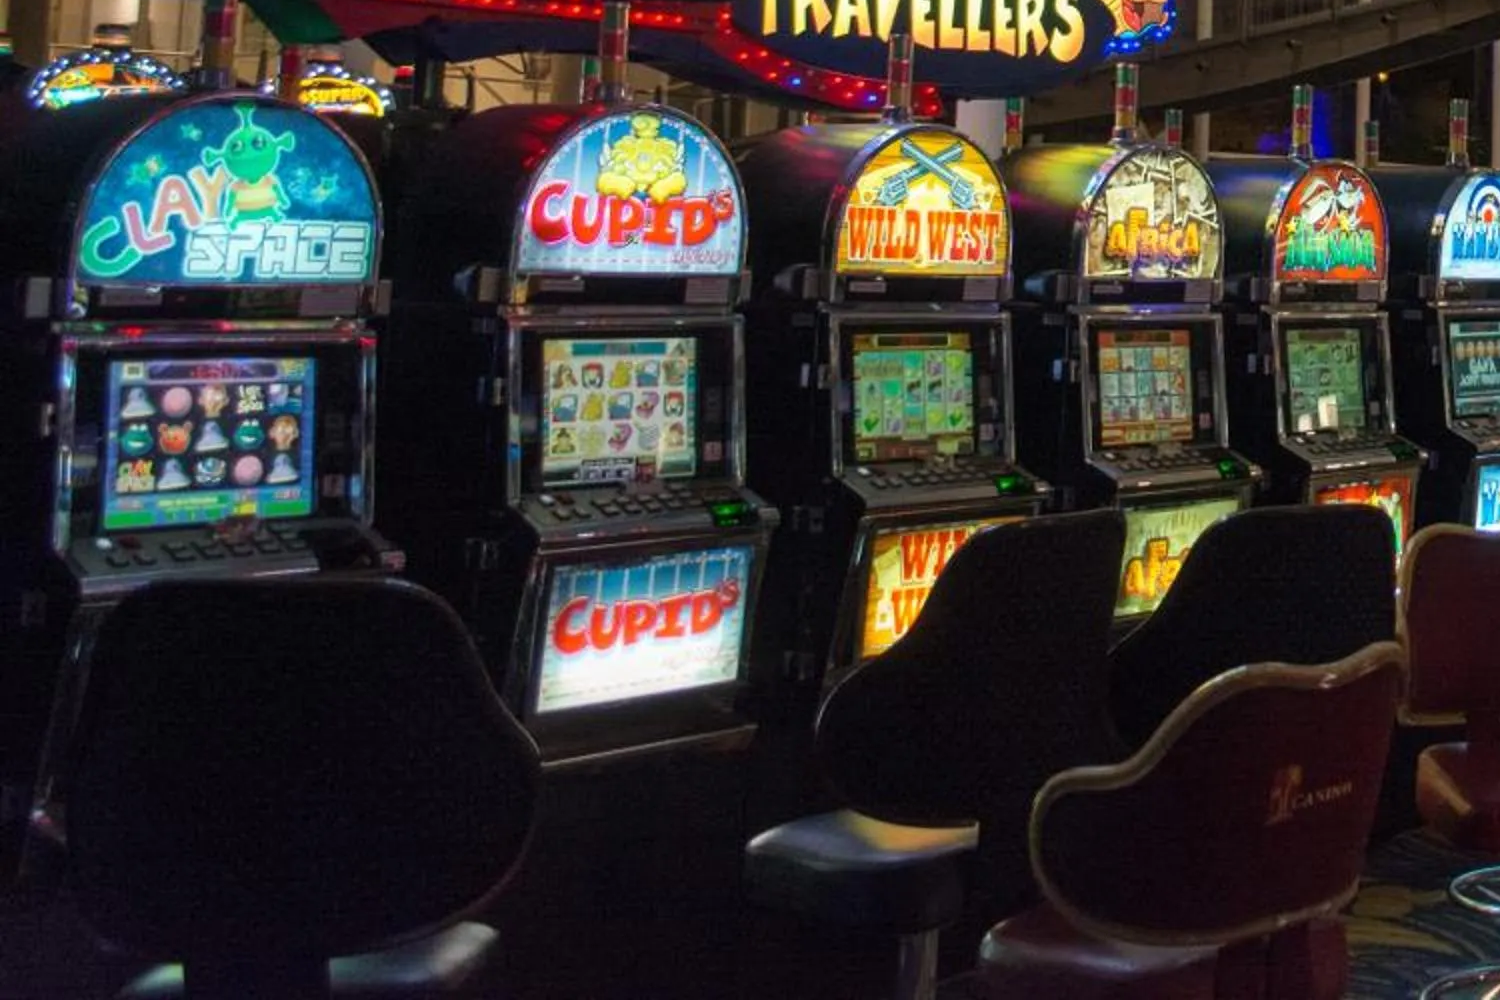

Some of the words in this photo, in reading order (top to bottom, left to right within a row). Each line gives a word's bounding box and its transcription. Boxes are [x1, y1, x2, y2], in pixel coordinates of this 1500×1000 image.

[80, 166, 226, 277] CLAY
[184, 220, 371, 279] SPACE
[848, 205, 921, 261] WILD
[927, 210, 1002, 263] WEST
[901, 527, 968, 582] WI
